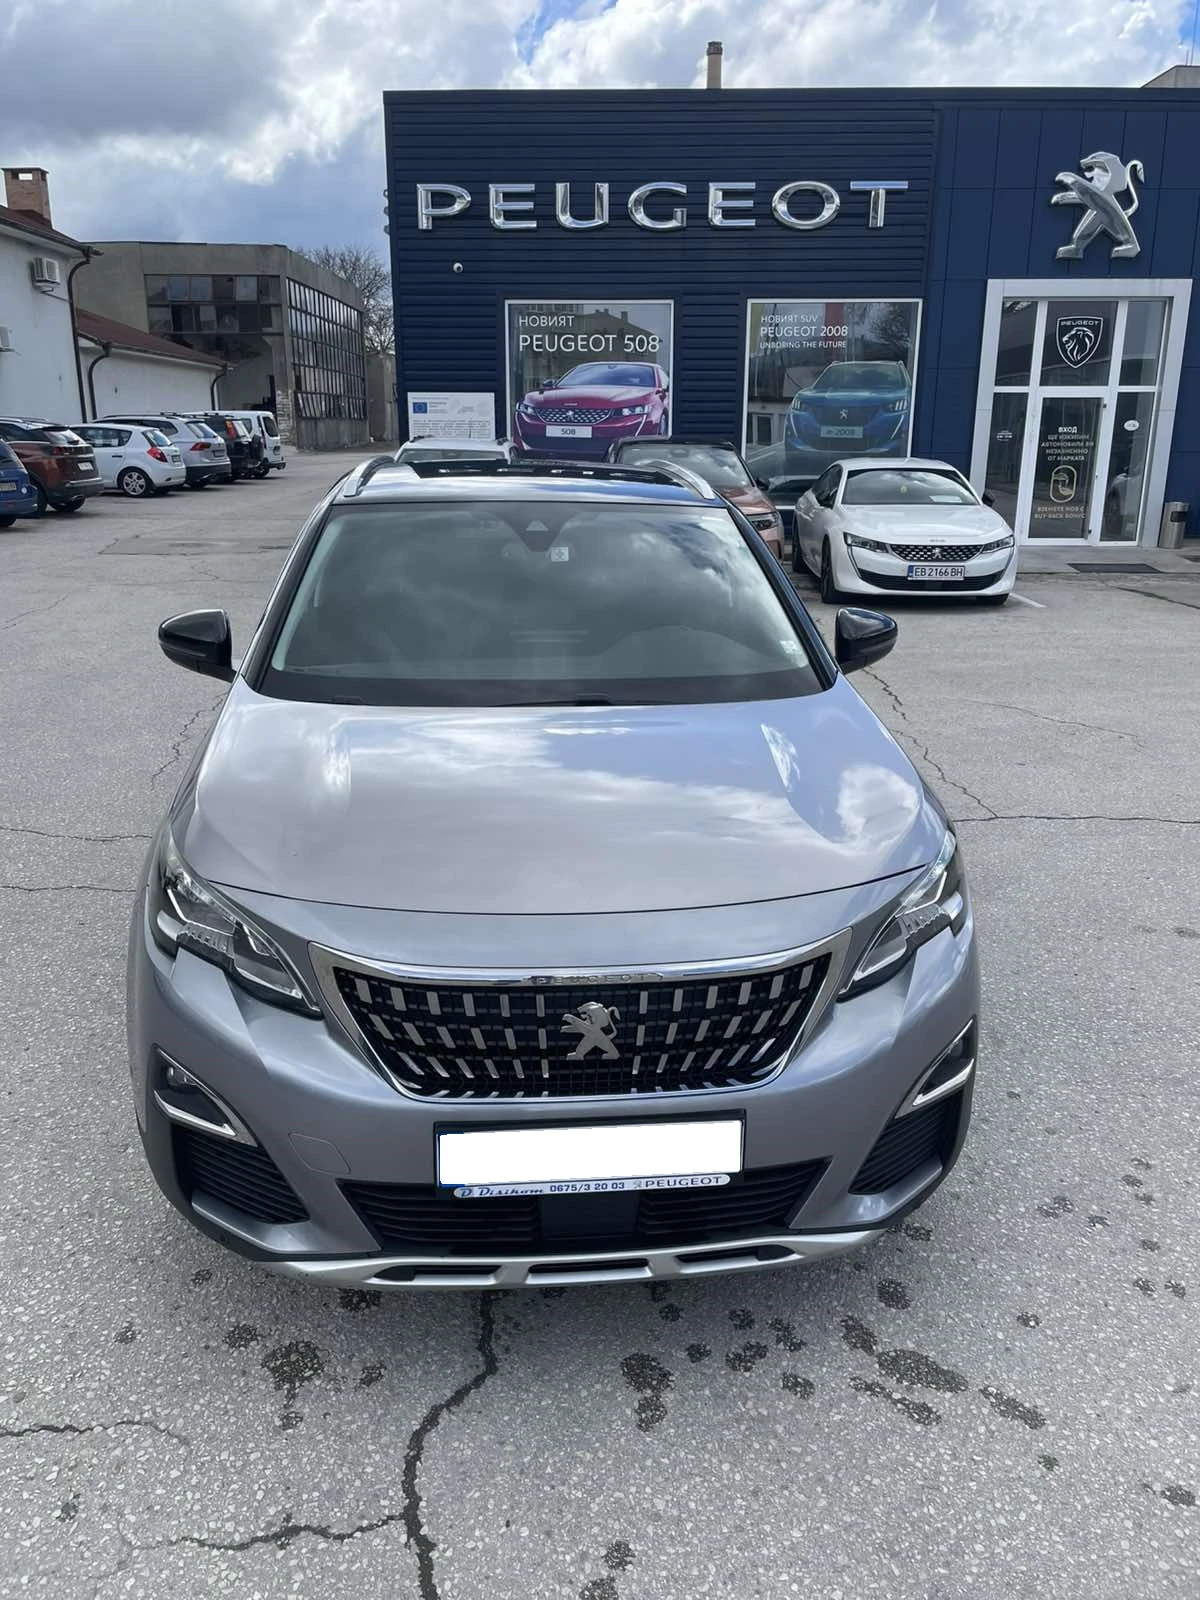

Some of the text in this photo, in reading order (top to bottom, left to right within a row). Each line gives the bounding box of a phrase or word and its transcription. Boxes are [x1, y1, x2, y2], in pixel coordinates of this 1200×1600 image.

[415, 180, 909, 231] PEUGEOT
[519, 315, 575, 327] НОВИЯТ
[760, 314, 818, 323] НОВИЯТ SUV
[759, 325, 848, 337] PEUGEOT 2008
[519, 334, 660, 352] PEUGEOT 508
[818, 340, 847, 348] FUTURE
[560, 428, 576, 436] 508
[914, 568, 963, 577] EB 2166 BH
[536, 973, 647, 985] PEUGEOT
[549, 1184, 591, 1193] 0675/3
[594, 1183, 608, 1191] 20
[611, 1182, 625, 1190] 03
[645, 1176, 722, 1188] PEUGEOT
